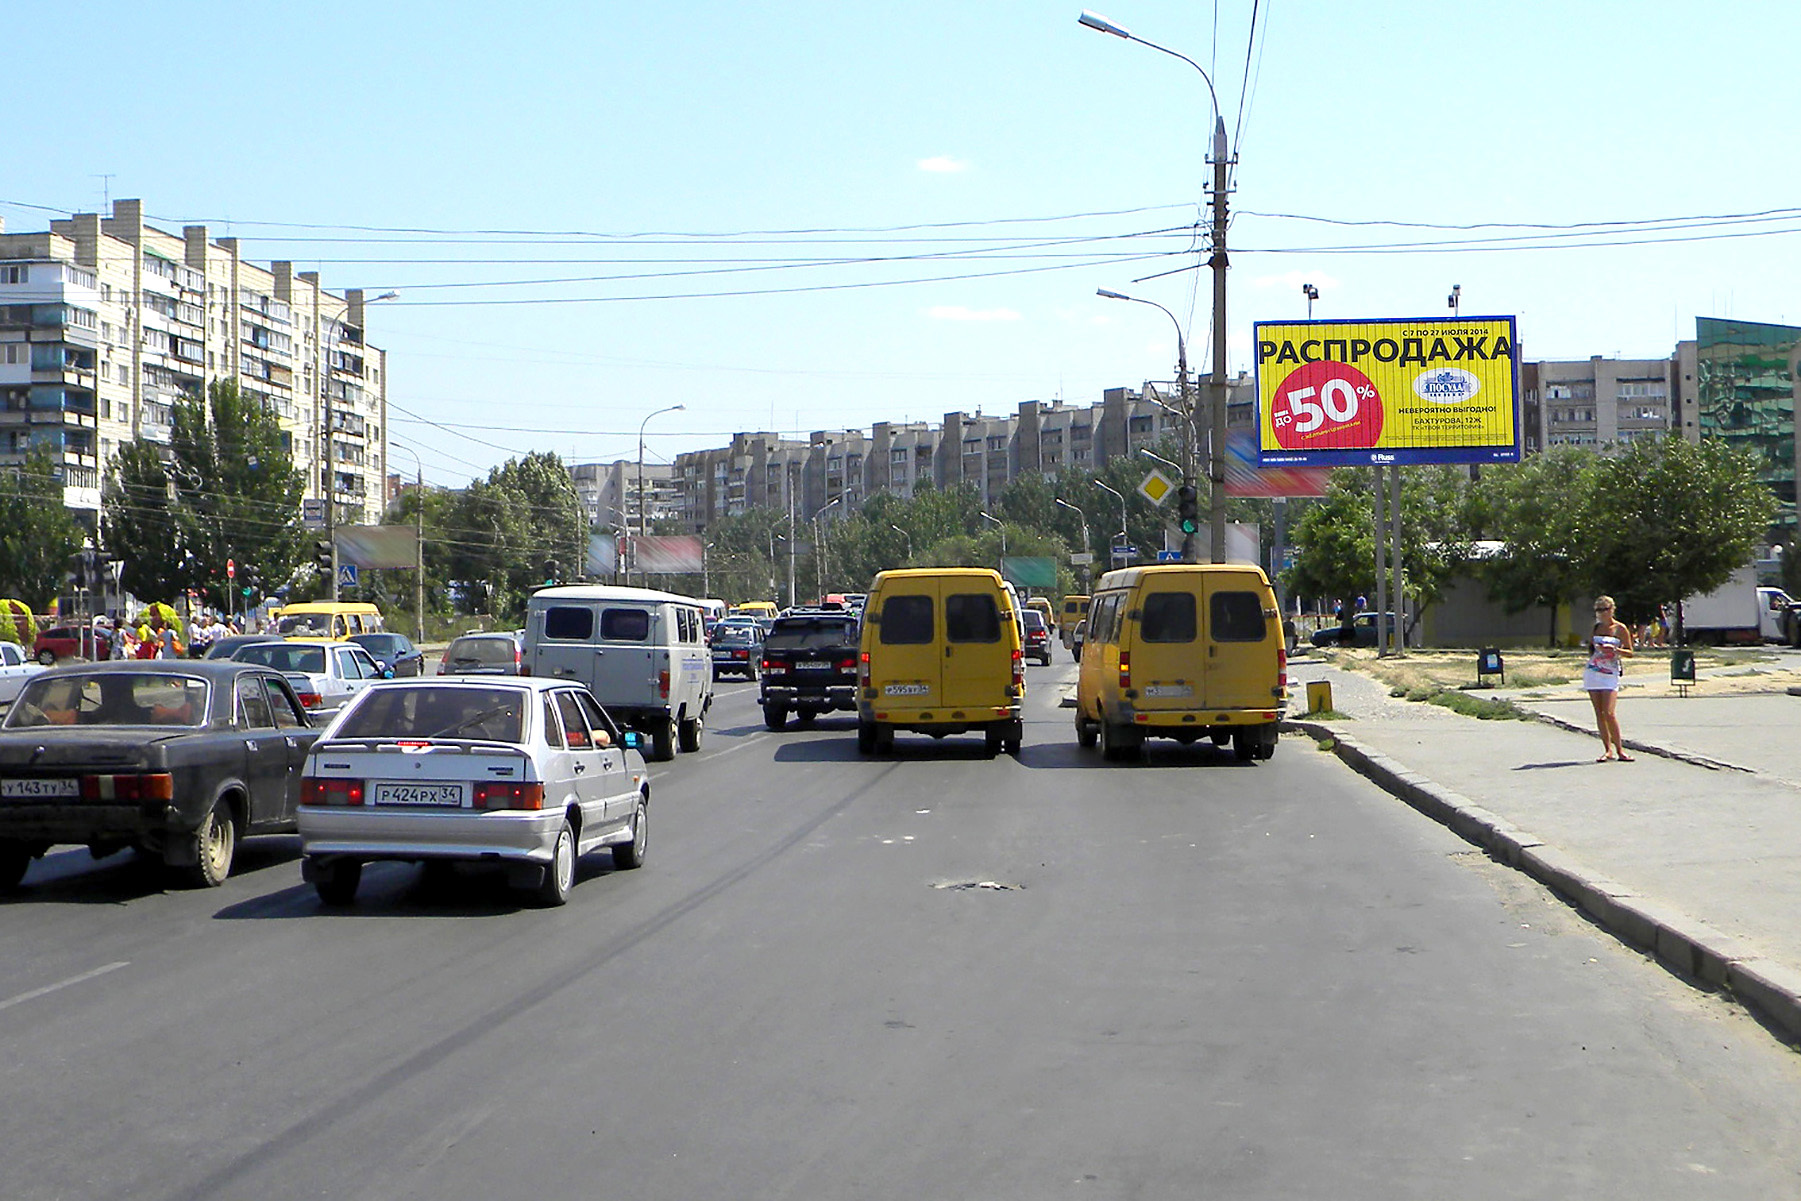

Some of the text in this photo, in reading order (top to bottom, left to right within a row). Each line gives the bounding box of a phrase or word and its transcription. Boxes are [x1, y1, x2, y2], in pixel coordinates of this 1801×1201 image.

[1259, 336, 1511, 367] РАСПРОДАЖА
[1398, 405, 1496, 414] НЕВЕРОЯТНО ВЫГОДНО!
[1414, 416, 1482, 425] БАХТУРОВА, 12Ж
[441, 786, 457, 799] 34
